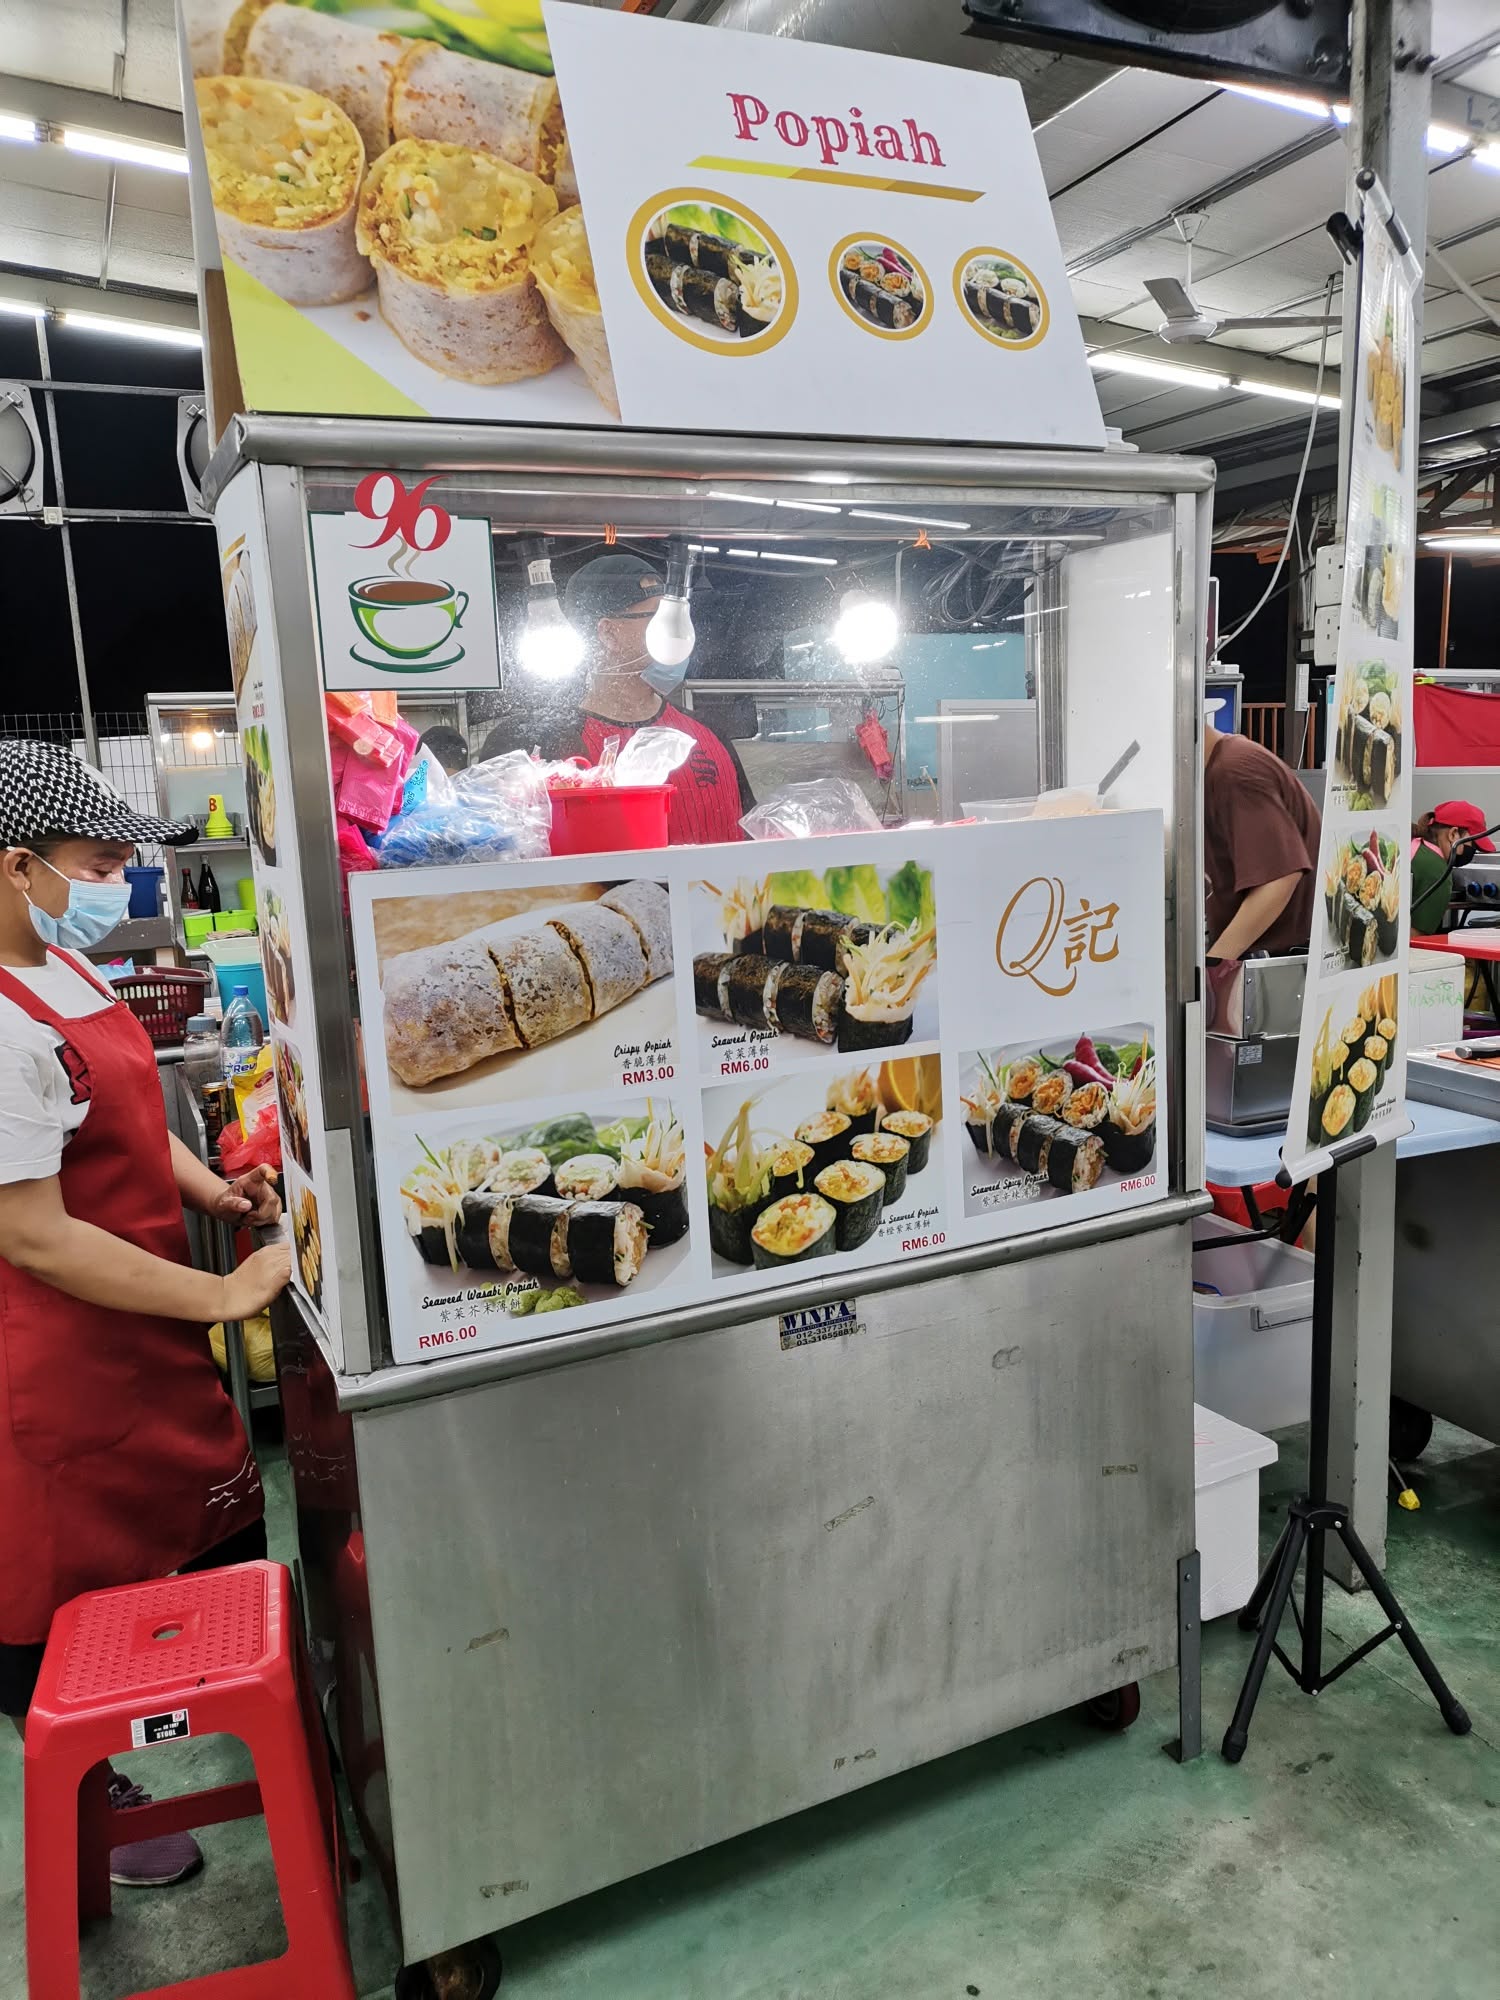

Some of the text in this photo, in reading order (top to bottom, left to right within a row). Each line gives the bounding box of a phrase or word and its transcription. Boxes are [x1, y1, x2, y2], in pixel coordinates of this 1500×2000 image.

[726, 93, 947, 167] Popiah
[347, 471, 453, 552] 96
[711, 1027, 778, 1048] Seaweed Popiah
[614, 1038, 672, 1058] Crispy Popiah
[622, 1066, 674, 1085] RM3.00
[721, 1057, 769, 1075] RM6.00
[971, 1181, 1000, 1196] Seaweed
[1003, 1178, 1022, 1190] Spicy
[1120, 1175, 1156, 1192] RM6.00
[889, 1210, 915, 1224] Seaweed
[918, 1206, 939, 1219] Popiah
[902, 1232, 946, 1252] RM6.00
[421, 1279, 539, 1309] Seaweed Wasabi Popiah
[783, 1301, 851, 1330] WINFA
[418, 1325, 477, 1349] RM6.00
